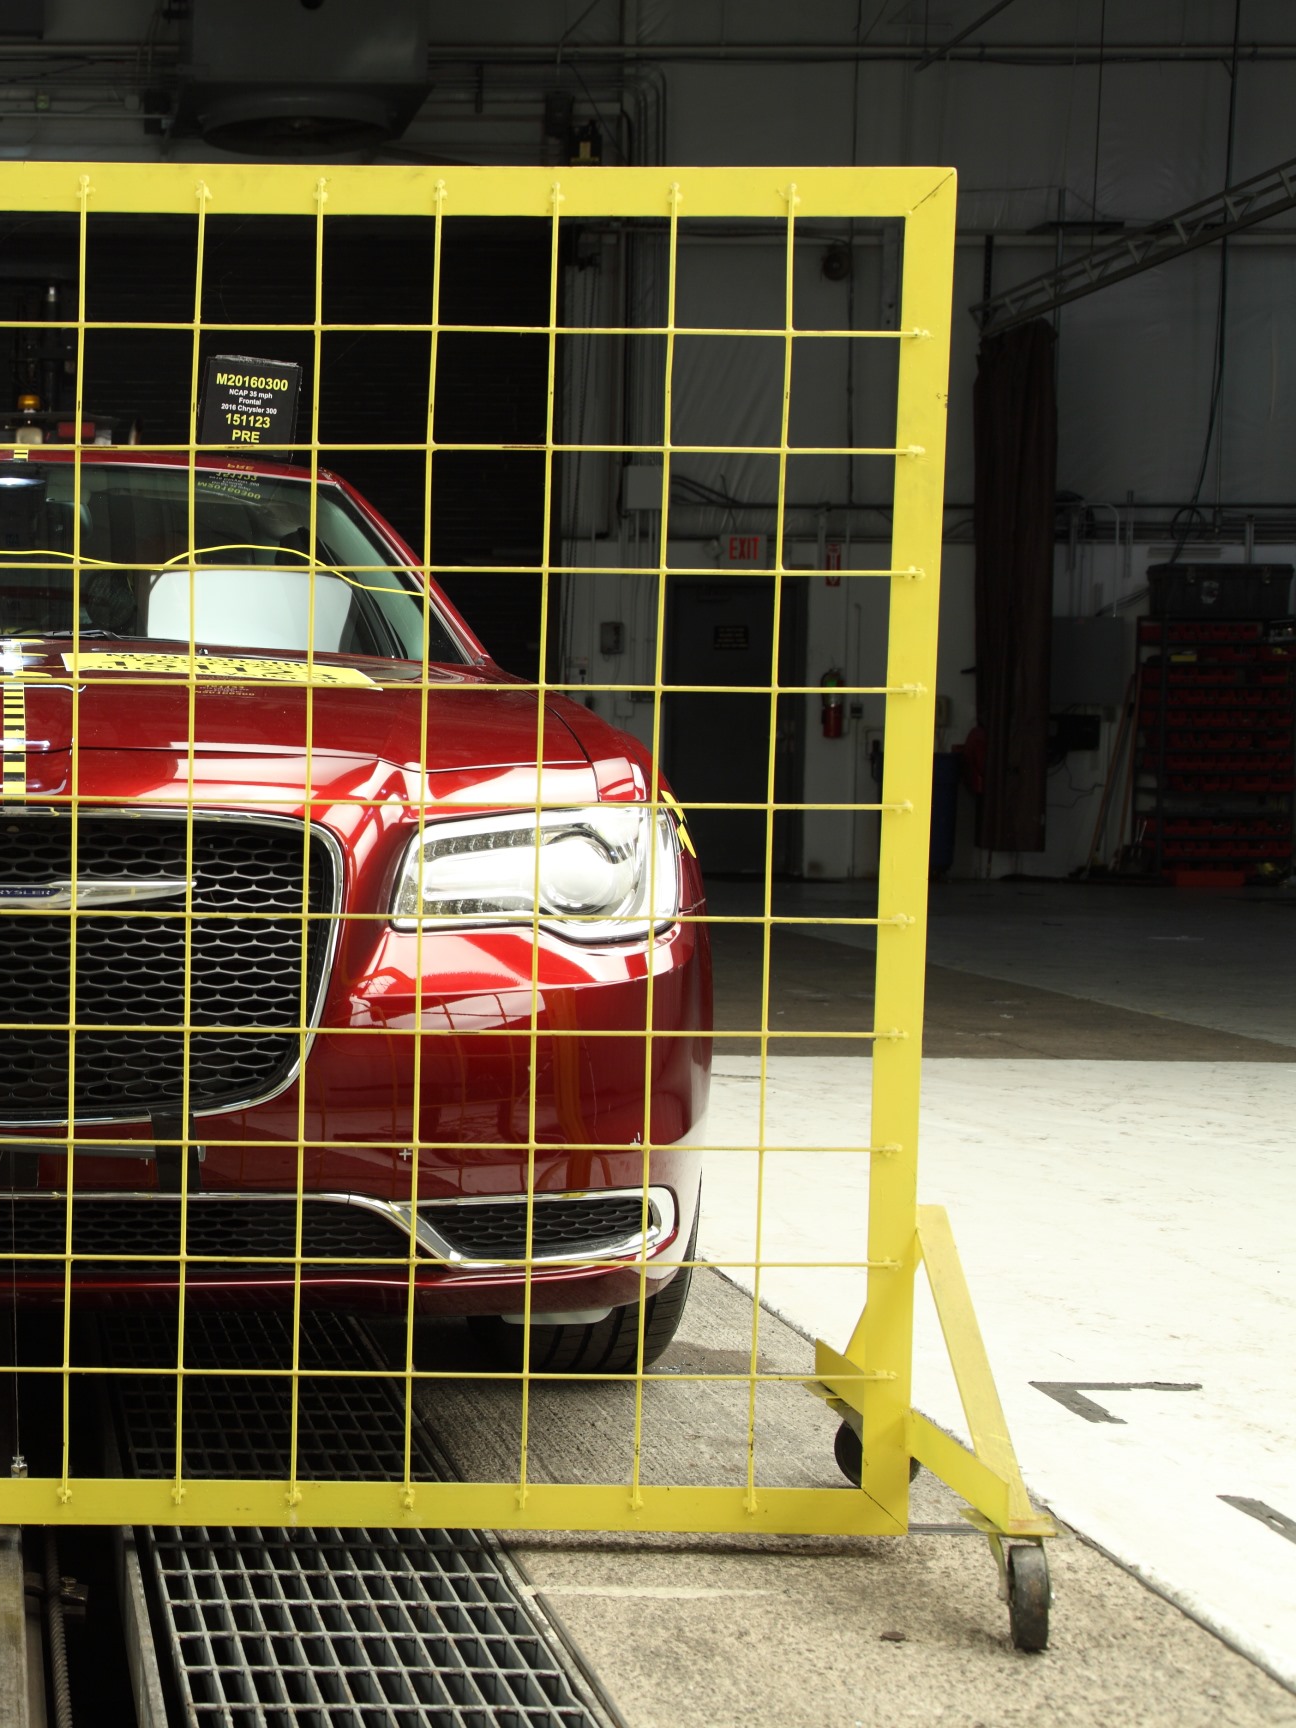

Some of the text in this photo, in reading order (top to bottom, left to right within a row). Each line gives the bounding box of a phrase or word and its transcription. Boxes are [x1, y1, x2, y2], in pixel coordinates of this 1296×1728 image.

[216, 373, 288, 391] M20160300
[238, 397, 262, 405] Frontal
[237, 405, 265, 413] Chrysler
[225, 413, 271, 428] 151123
[232, 430, 260, 443] PRE
[729, 536, 760, 560] EXIT
